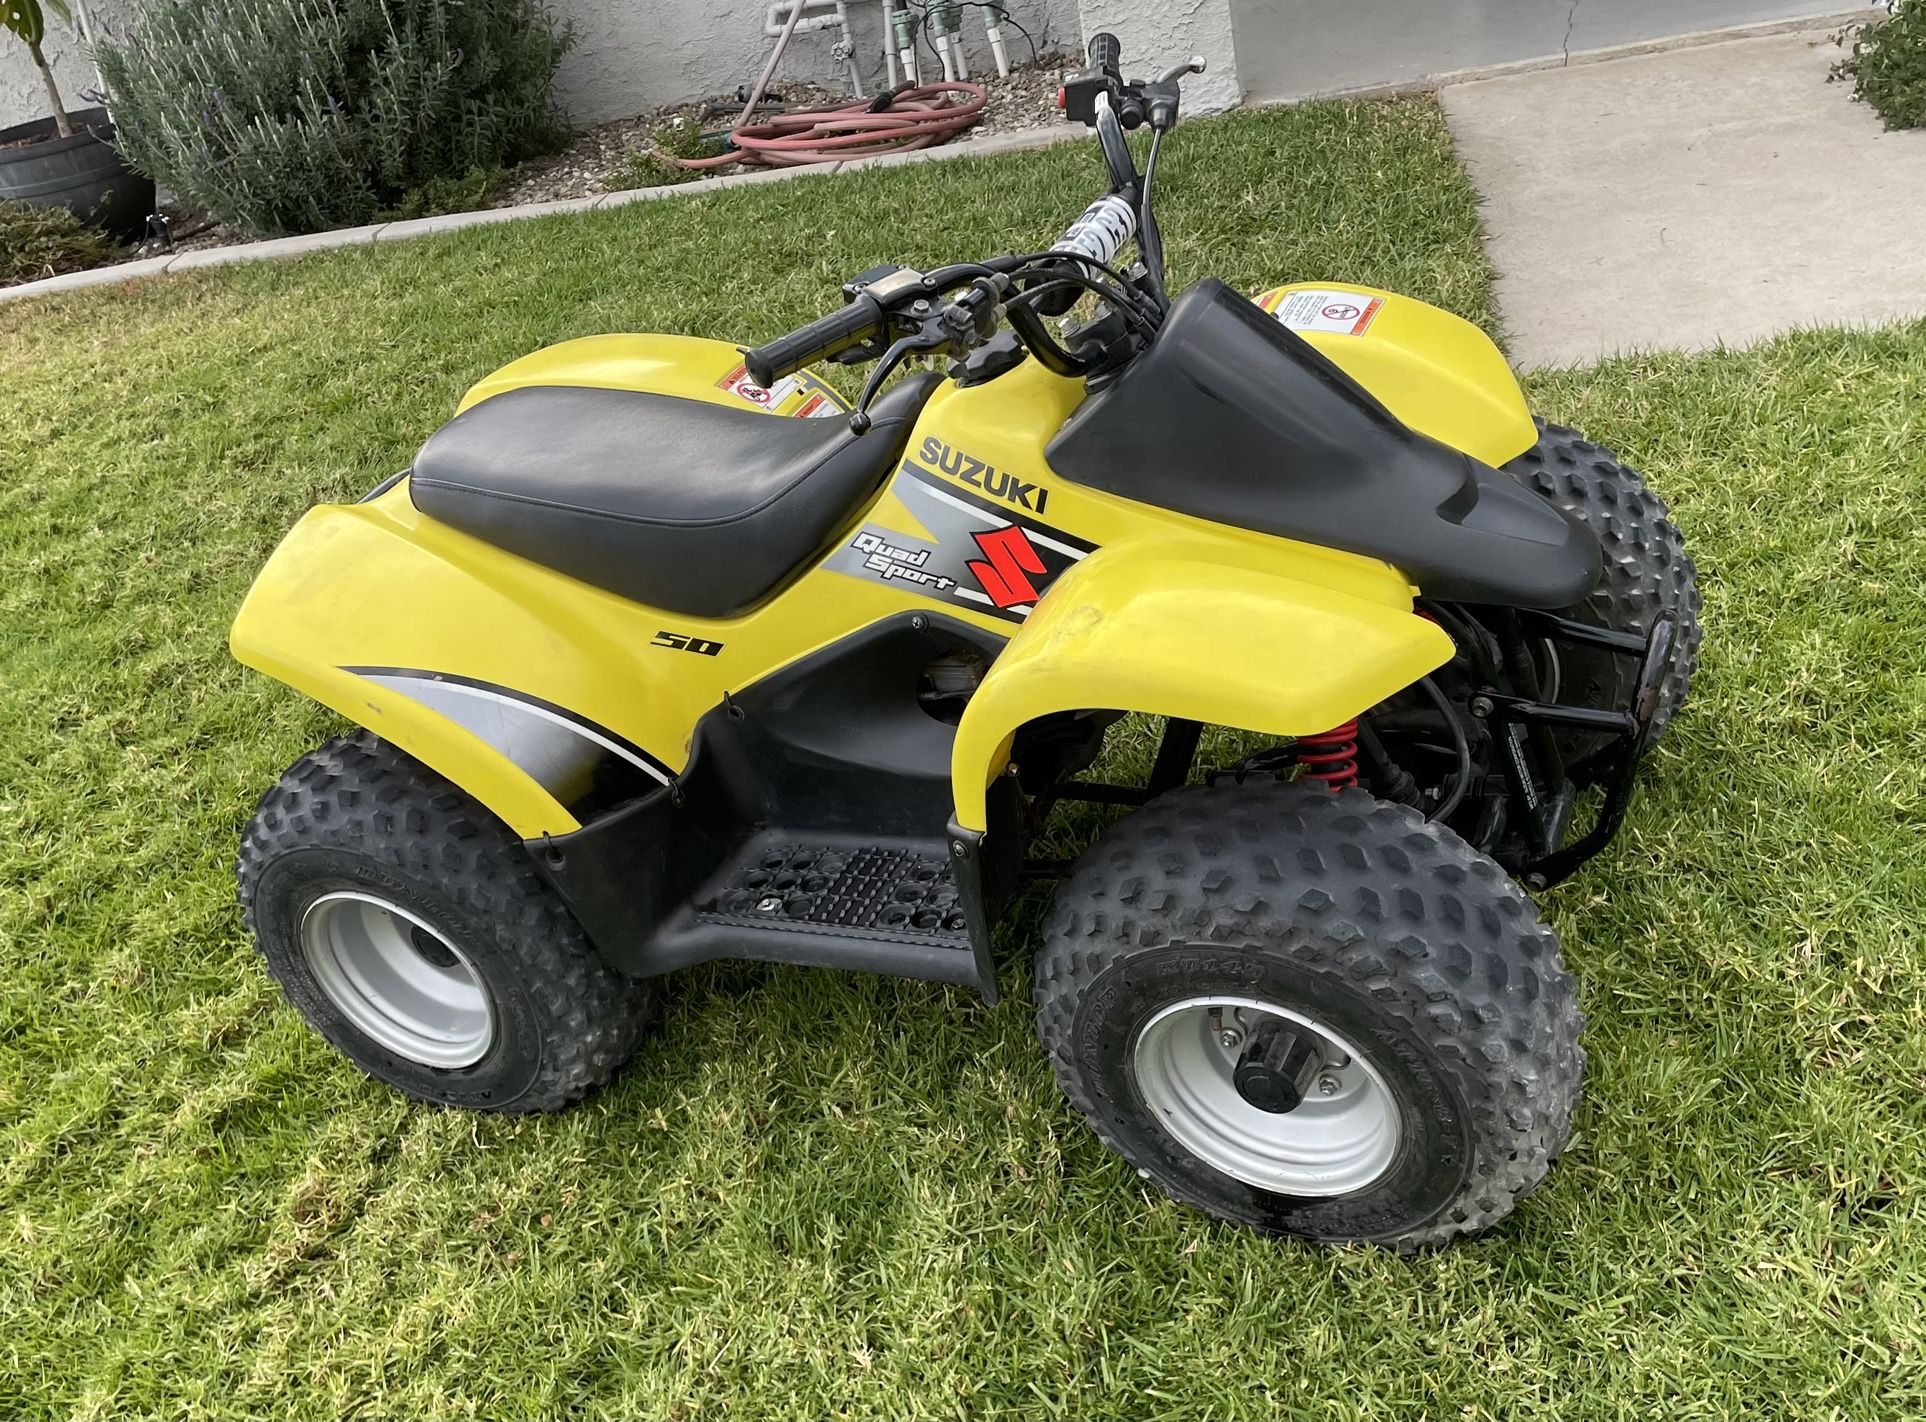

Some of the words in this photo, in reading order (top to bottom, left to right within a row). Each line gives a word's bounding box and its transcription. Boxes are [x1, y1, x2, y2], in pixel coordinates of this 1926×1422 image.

[919, 436, 1049, 515] SUZUKI
[850, 531, 931, 567] Quad
[862, 554, 957, 590] Sport
[650, 630, 725, 657] 50
